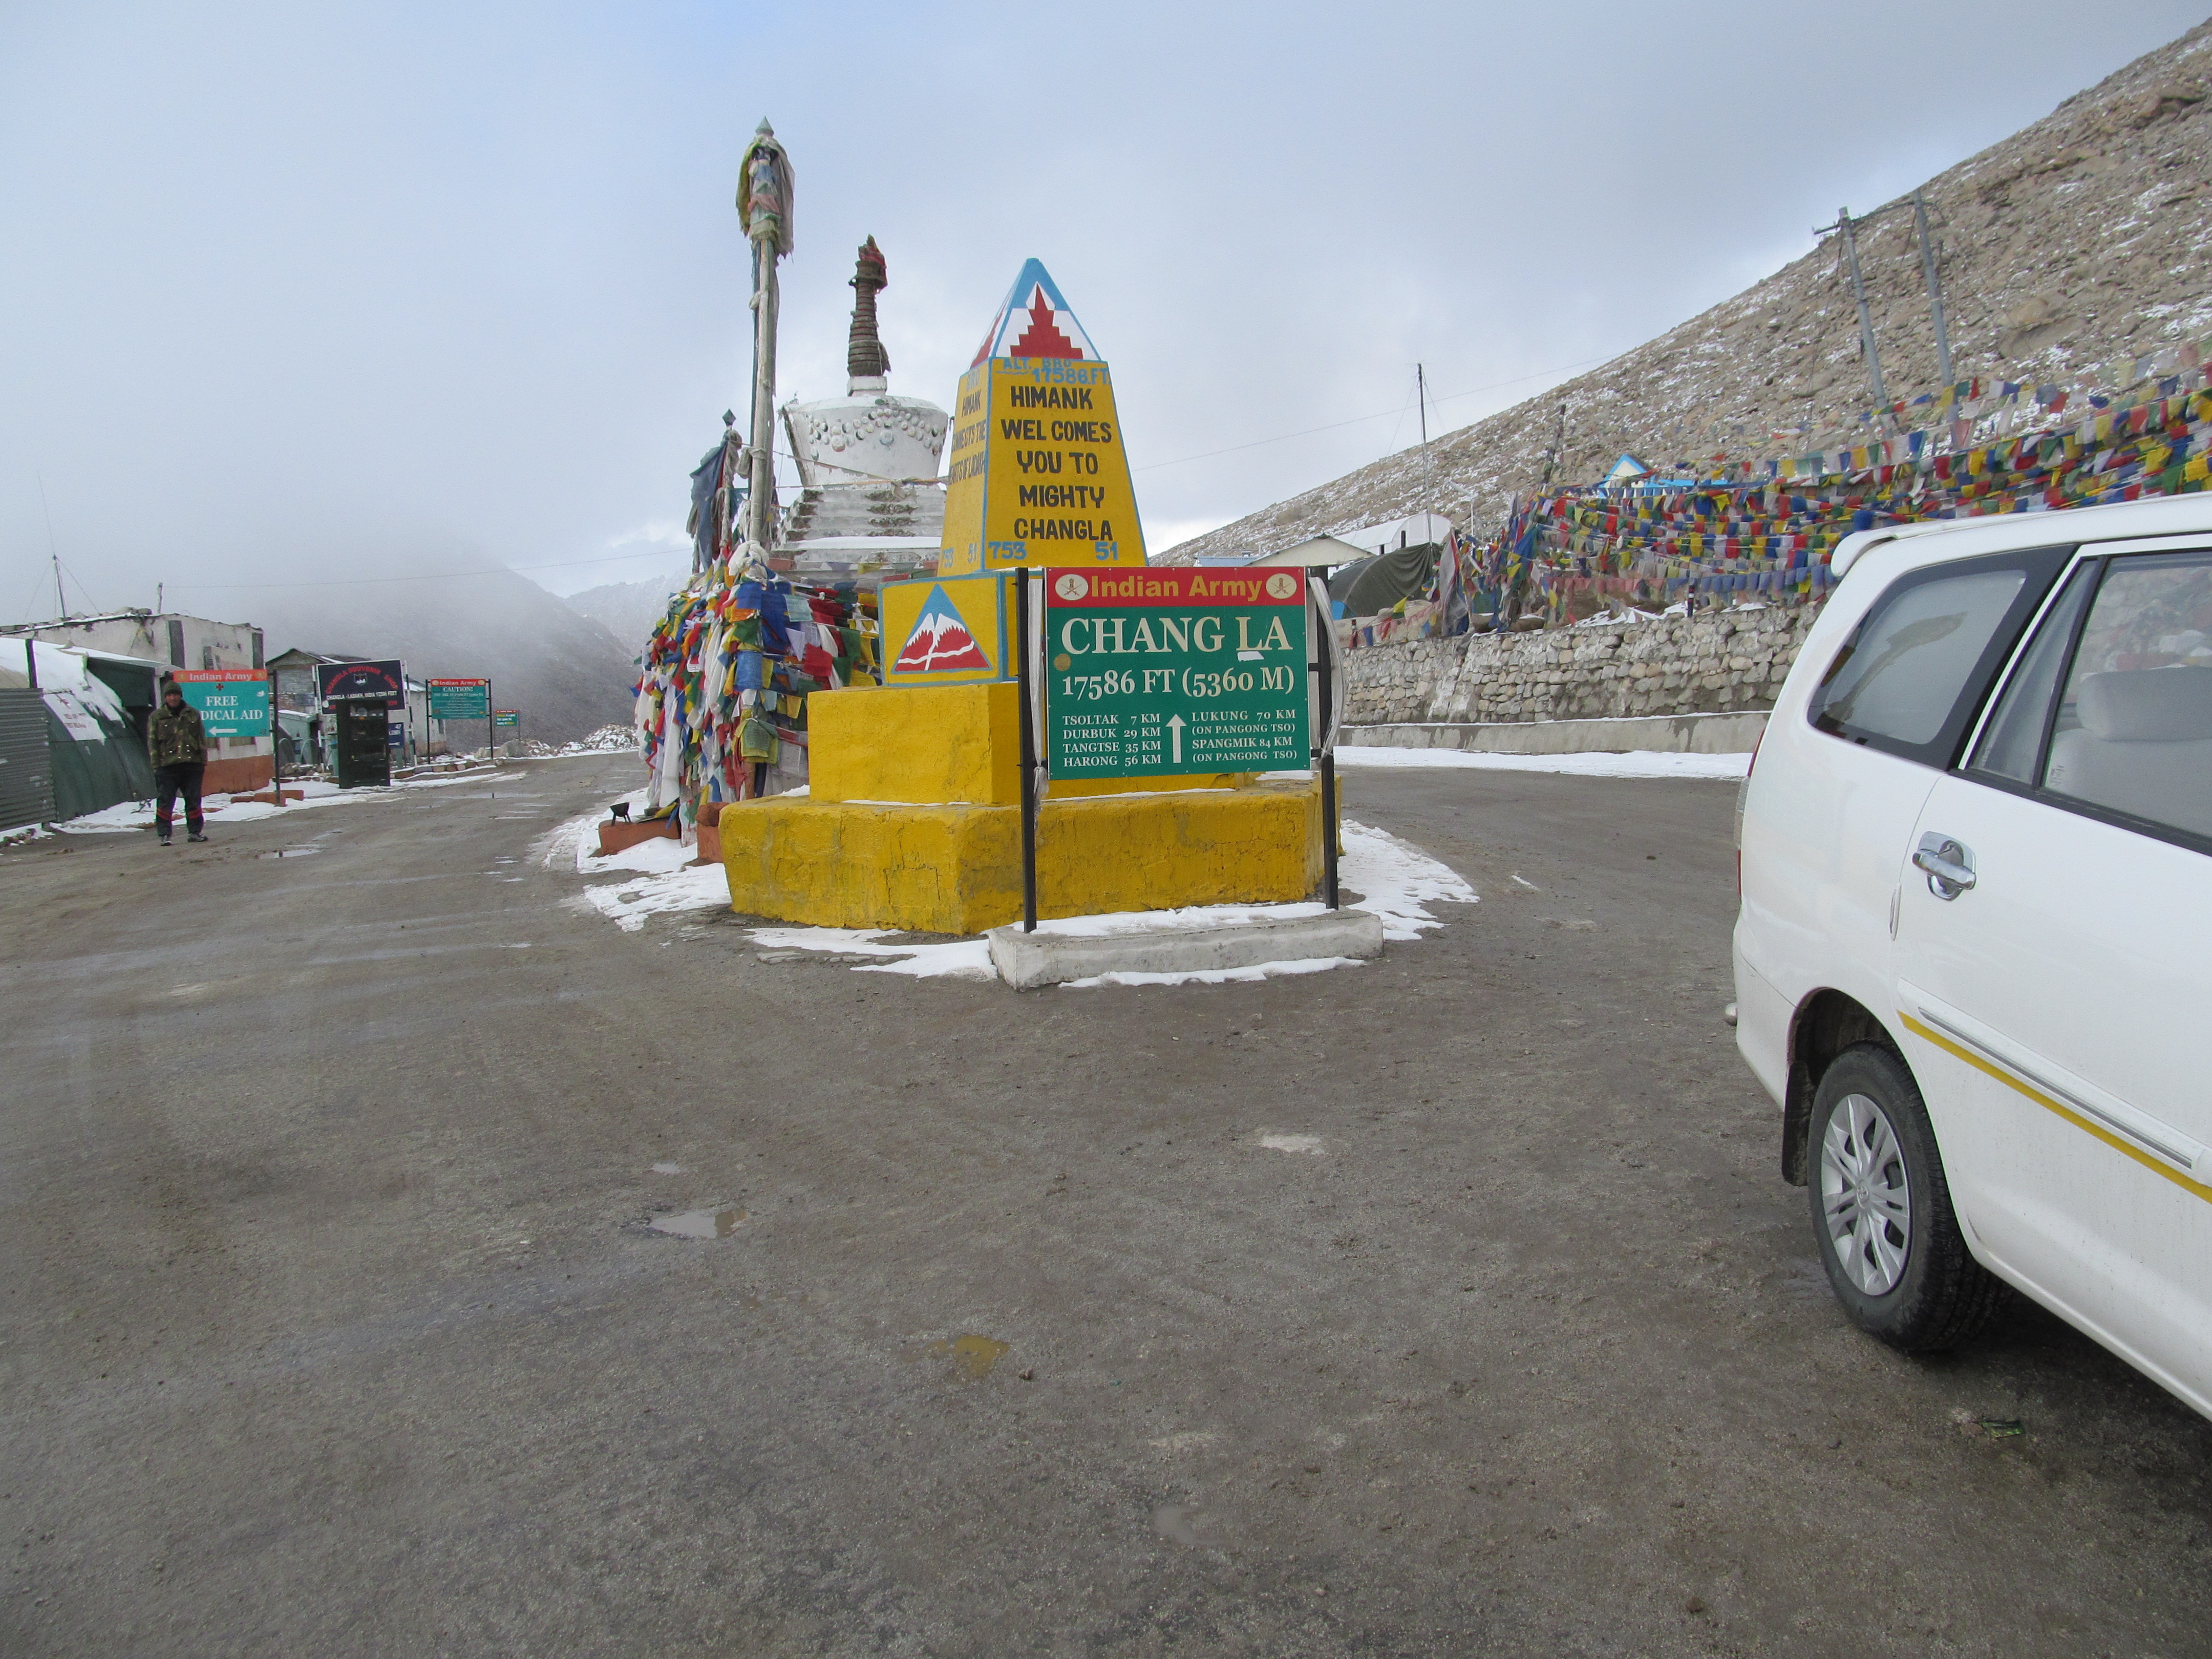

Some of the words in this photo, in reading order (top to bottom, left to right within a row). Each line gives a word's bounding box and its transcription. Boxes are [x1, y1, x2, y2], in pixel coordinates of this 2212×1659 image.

[1010, 386, 1093, 410] HIMANK
[1016, 450, 1062, 474] YOU
[1068, 452, 1098, 475] TO
[1019, 484, 1104, 508] MIGHTY
[1014, 518, 1113, 541] CHANGLA
[988, 541, 1027, 560] 753
[1095, 541, 1118, 561] 51
[1092, 576, 1179, 597] Indian
[1188, 575, 1262, 602] Army
[1061, 616, 1225, 654] CHANG
[1235, 616, 1293, 651] LA
[225, 672, 252, 682] Army
[1062, 670, 1135, 700] 17586
[1142, 669, 1176, 693] FT
[1182, 667, 1253, 697] (5360
[1260, 665, 1294, 694] M)
[206, 695, 239, 707] FREE
[201, 710, 237, 721] DICAL
[240, 709, 263, 720] AID
[1062, 715, 1119, 725] TSOLTAK
[1130, 716, 1137, 725] 7
[1141, 713, 1161, 723] KM
[1192, 711, 1248, 721] LUKUNG
[1257, 712, 1271, 721] 70
[1276, 709, 1296, 719] KM
[1063, 729, 1117, 739] DURBUK
[1124, 729, 1138, 739] 29
[1141, 727, 1161, 737] KM
[1192, 726, 1211, 735] (ON
[1216, 724, 1268, 734] PANGONG
[1271, 723, 1295, 733] TSO)
[1063, 742, 1120, 753] TANGTSE
[1125, 743, 1139, 754] 35
[1141, 740, 1161, 751] KM
[1192, 738, 1257, 749] SPANGMIK
[1259, 739, 1271, 749] 84
[1274, 736, 1293, 746] KM
[1064, 756, 1118, 767] HARONG
[1124, 755, 1139, 767] 56
[1142, 754, 1161, 764] KM
[1193, 753, 1212, 762] (ON
[1216, 751, 1268, 761] PANGONG
[1273, 750, 1298, 760] TSO)
